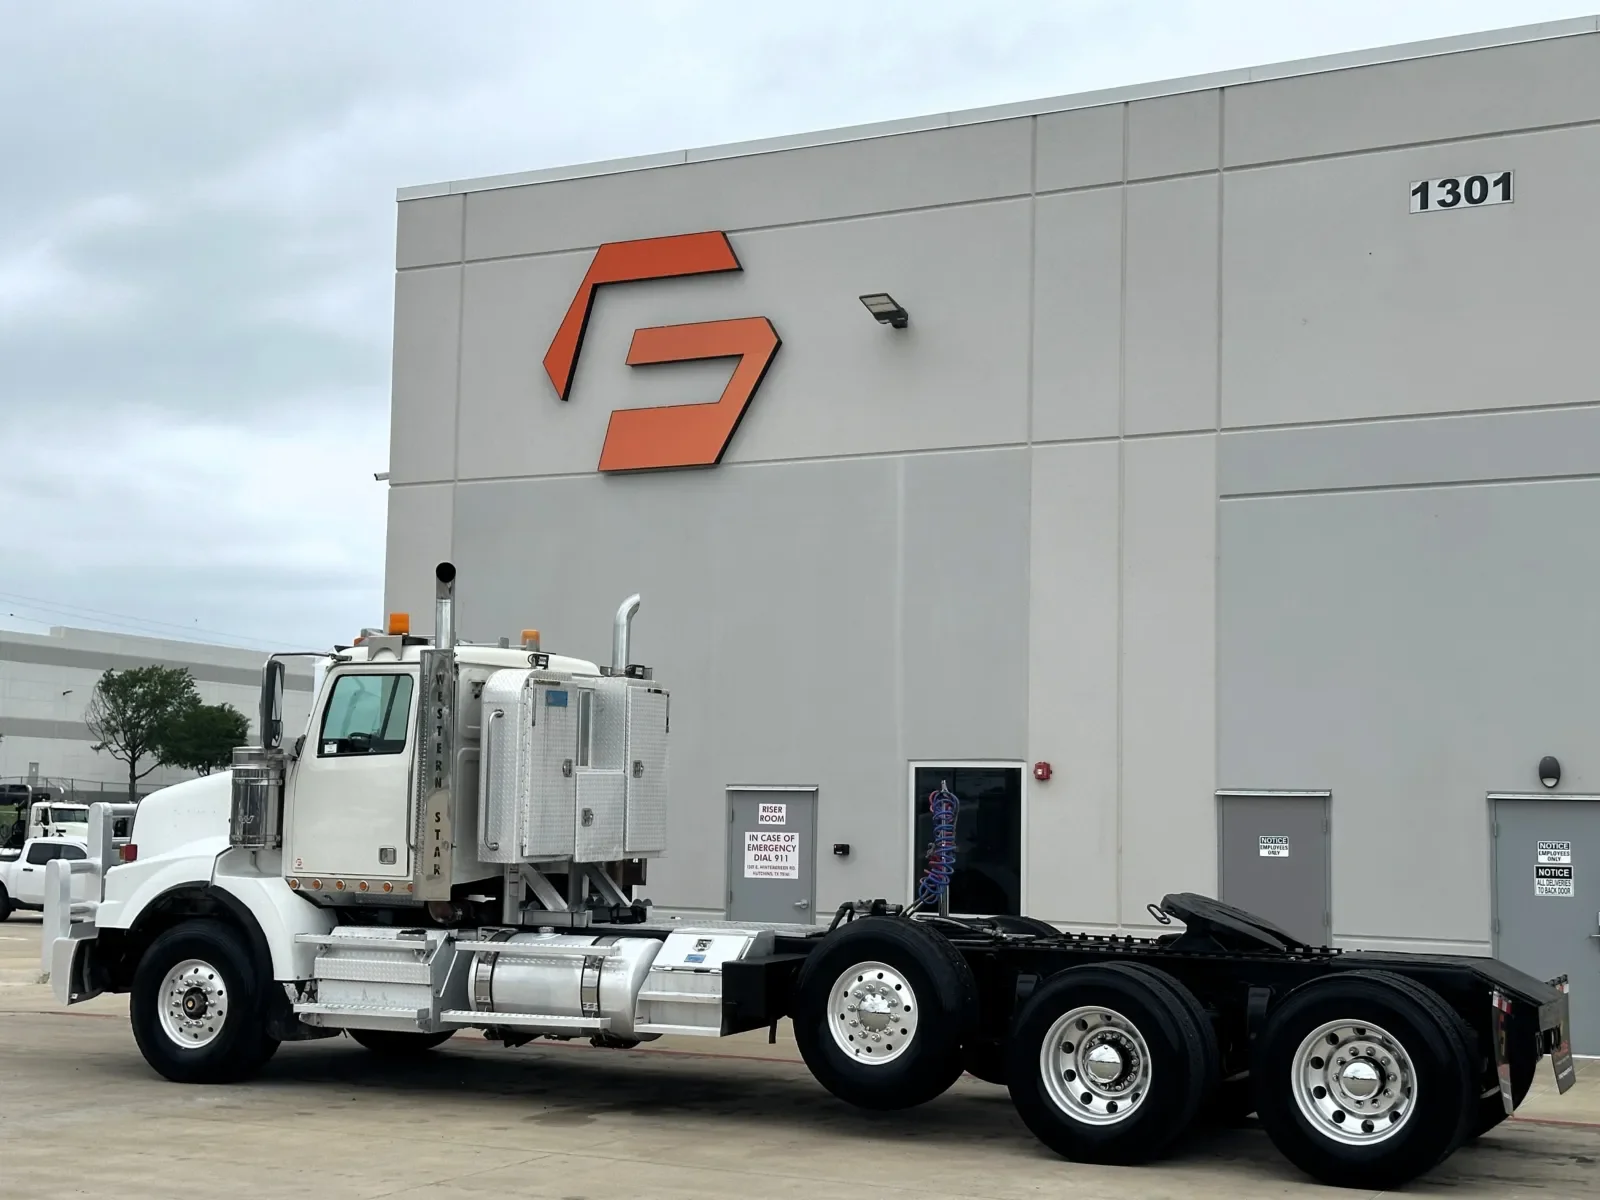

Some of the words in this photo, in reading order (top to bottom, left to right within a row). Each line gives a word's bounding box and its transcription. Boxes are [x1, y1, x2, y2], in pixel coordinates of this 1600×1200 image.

[1411, 171, 1511, 210] 1301
[434, 673, 445, 789] WESTERN
[762, 805, 783, 813] RISER
[759, 814, 785, 823] ROOM
[749, 834, 759, 842] IN
[760, 834, 781, 842] CASE
[783, 834, 795, 842] OF
[433, 811, 441, 875] STAR
[1539, 842, 1569, 850] NOTICE
[747, 843, 797, 853] EMERGENCY
[754, 853, 772, 861] DIAL
[774, 854, 788, 862] 911
[1538, 868, 1570, 877] NOTICE
